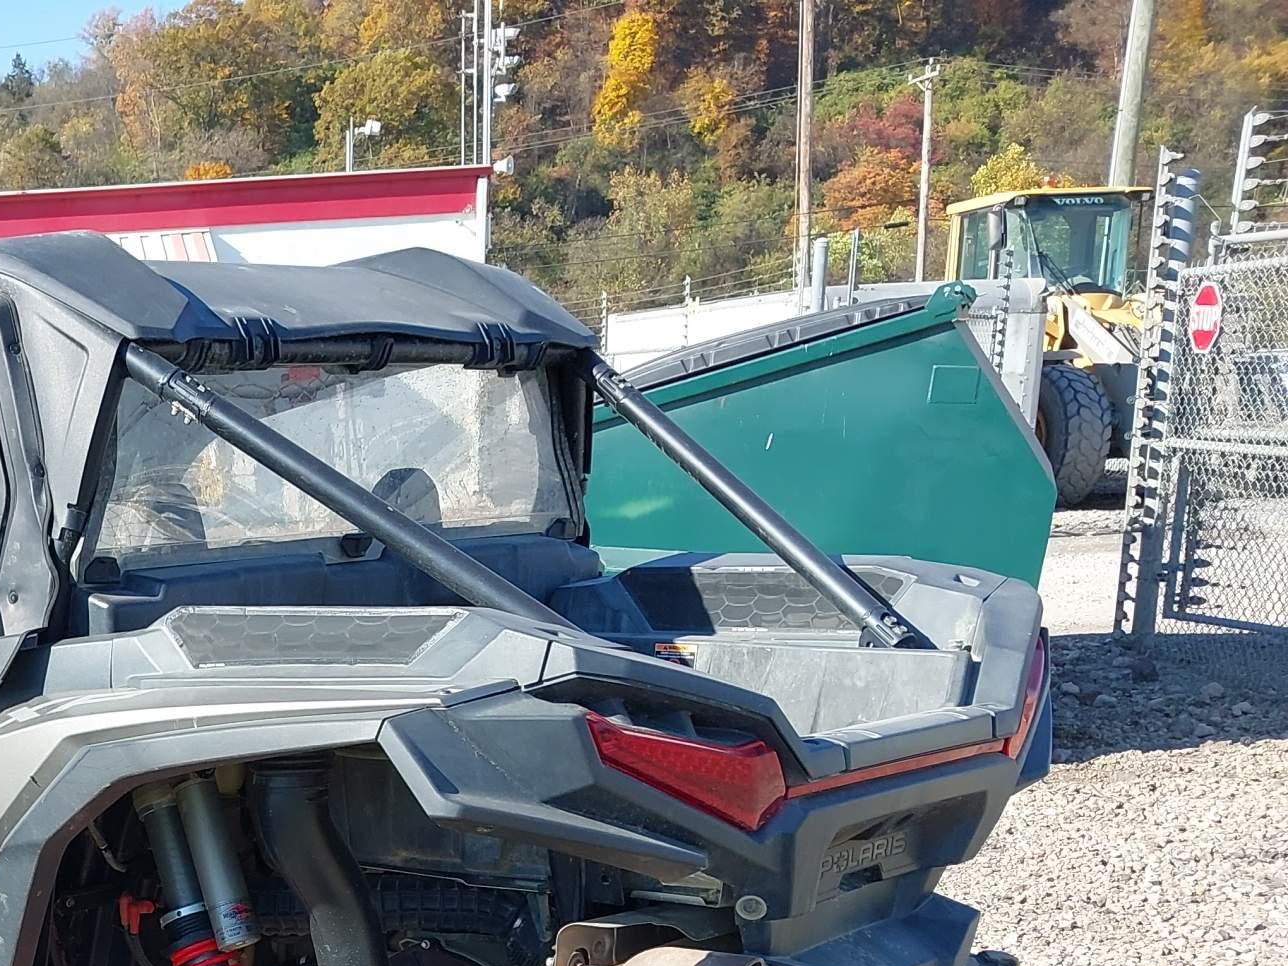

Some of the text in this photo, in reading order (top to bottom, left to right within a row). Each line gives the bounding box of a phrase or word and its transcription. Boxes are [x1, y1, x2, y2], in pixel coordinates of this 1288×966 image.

[1052, 196, 1105, 206] VOLVO
[1191, 305, 1220, 331] STOP
[821, 832, 907, 873] POLARIS
